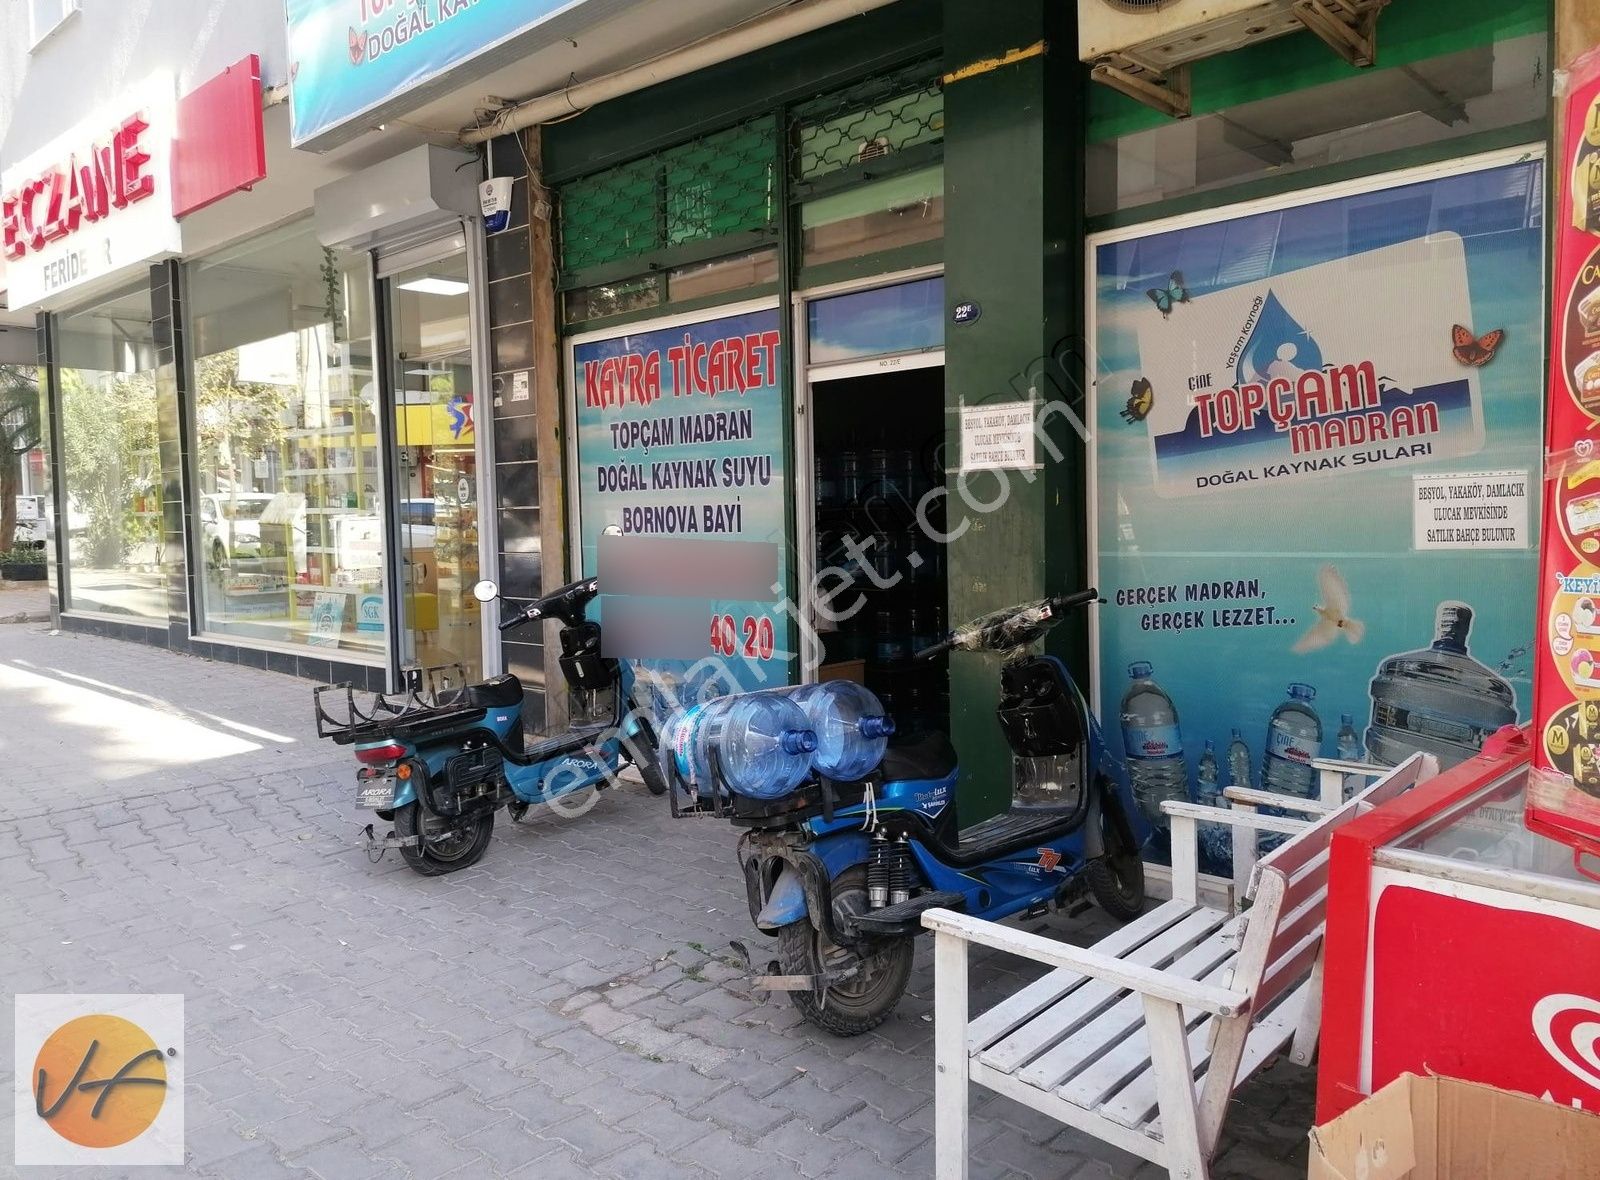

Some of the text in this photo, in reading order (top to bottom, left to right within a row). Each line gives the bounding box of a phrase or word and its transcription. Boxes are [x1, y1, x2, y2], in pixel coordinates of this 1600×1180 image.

[367, 6, 434, 61] DOĞAL
[438, 0, 480, 22] KA
[3, 111, 155, 262] ECZANE
[584, 350, 661, 411] KAYRA
[668, 332, 781, 399] TİCARET
[1225, 336, 1246, 370] Yaşam
[1194, 360, 1381, 438] TOPÇAM
[611, 409, 752, 455] TOPÇAM MADRAN
[1290, 400, 1440, 455] MADRAN
[598, 455, 771, 492] DOĞAL KAYNAK SUYU
[1196, 442, 1433, 489] DOĞAL KAYNAK SULARI
[1448, 481, 1485, 501] YAKAKÖY,
[1486, 482, 1524, 499] DAMLACIK
[623, 495, 742, 534] BORNOVA BAYİ
[1433, 502, 1508, 521] ULUCAK MEVKİSİNDE
[1427, 527, 1516, 546] SATILIK BAHÇE BULUNUR
[1116, 578, 1266, 608] GERÇEK MADRAN,
[710, 613, 775, 660] 40 20
[1141, 606, 1296, 634] GERÇEK LEZZET...
[561, 758, 598, 770] ARORA
